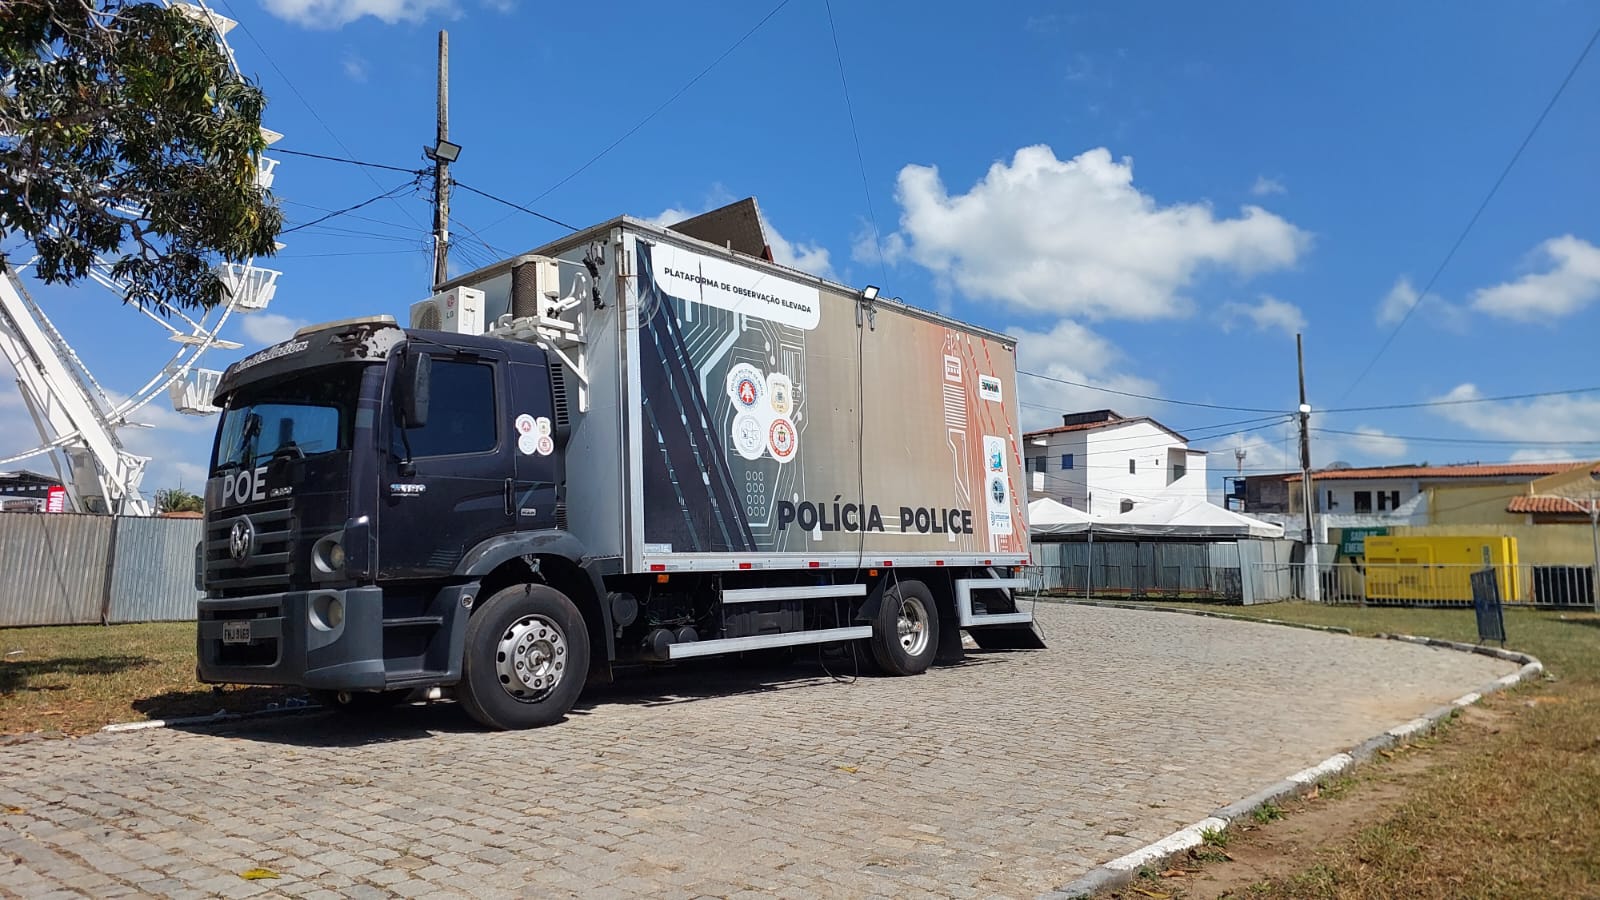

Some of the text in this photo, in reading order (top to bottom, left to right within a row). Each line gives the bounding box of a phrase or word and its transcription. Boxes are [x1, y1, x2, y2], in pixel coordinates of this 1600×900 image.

[664, 267, 811, 313] PLATAFORMA DE OBSERVAÇÃO ELEVADA
[222, 466, 269, 508] POE
[777, 494, 885, 532] POLÍCIA
[900, 506, 974, 535] POLICE
